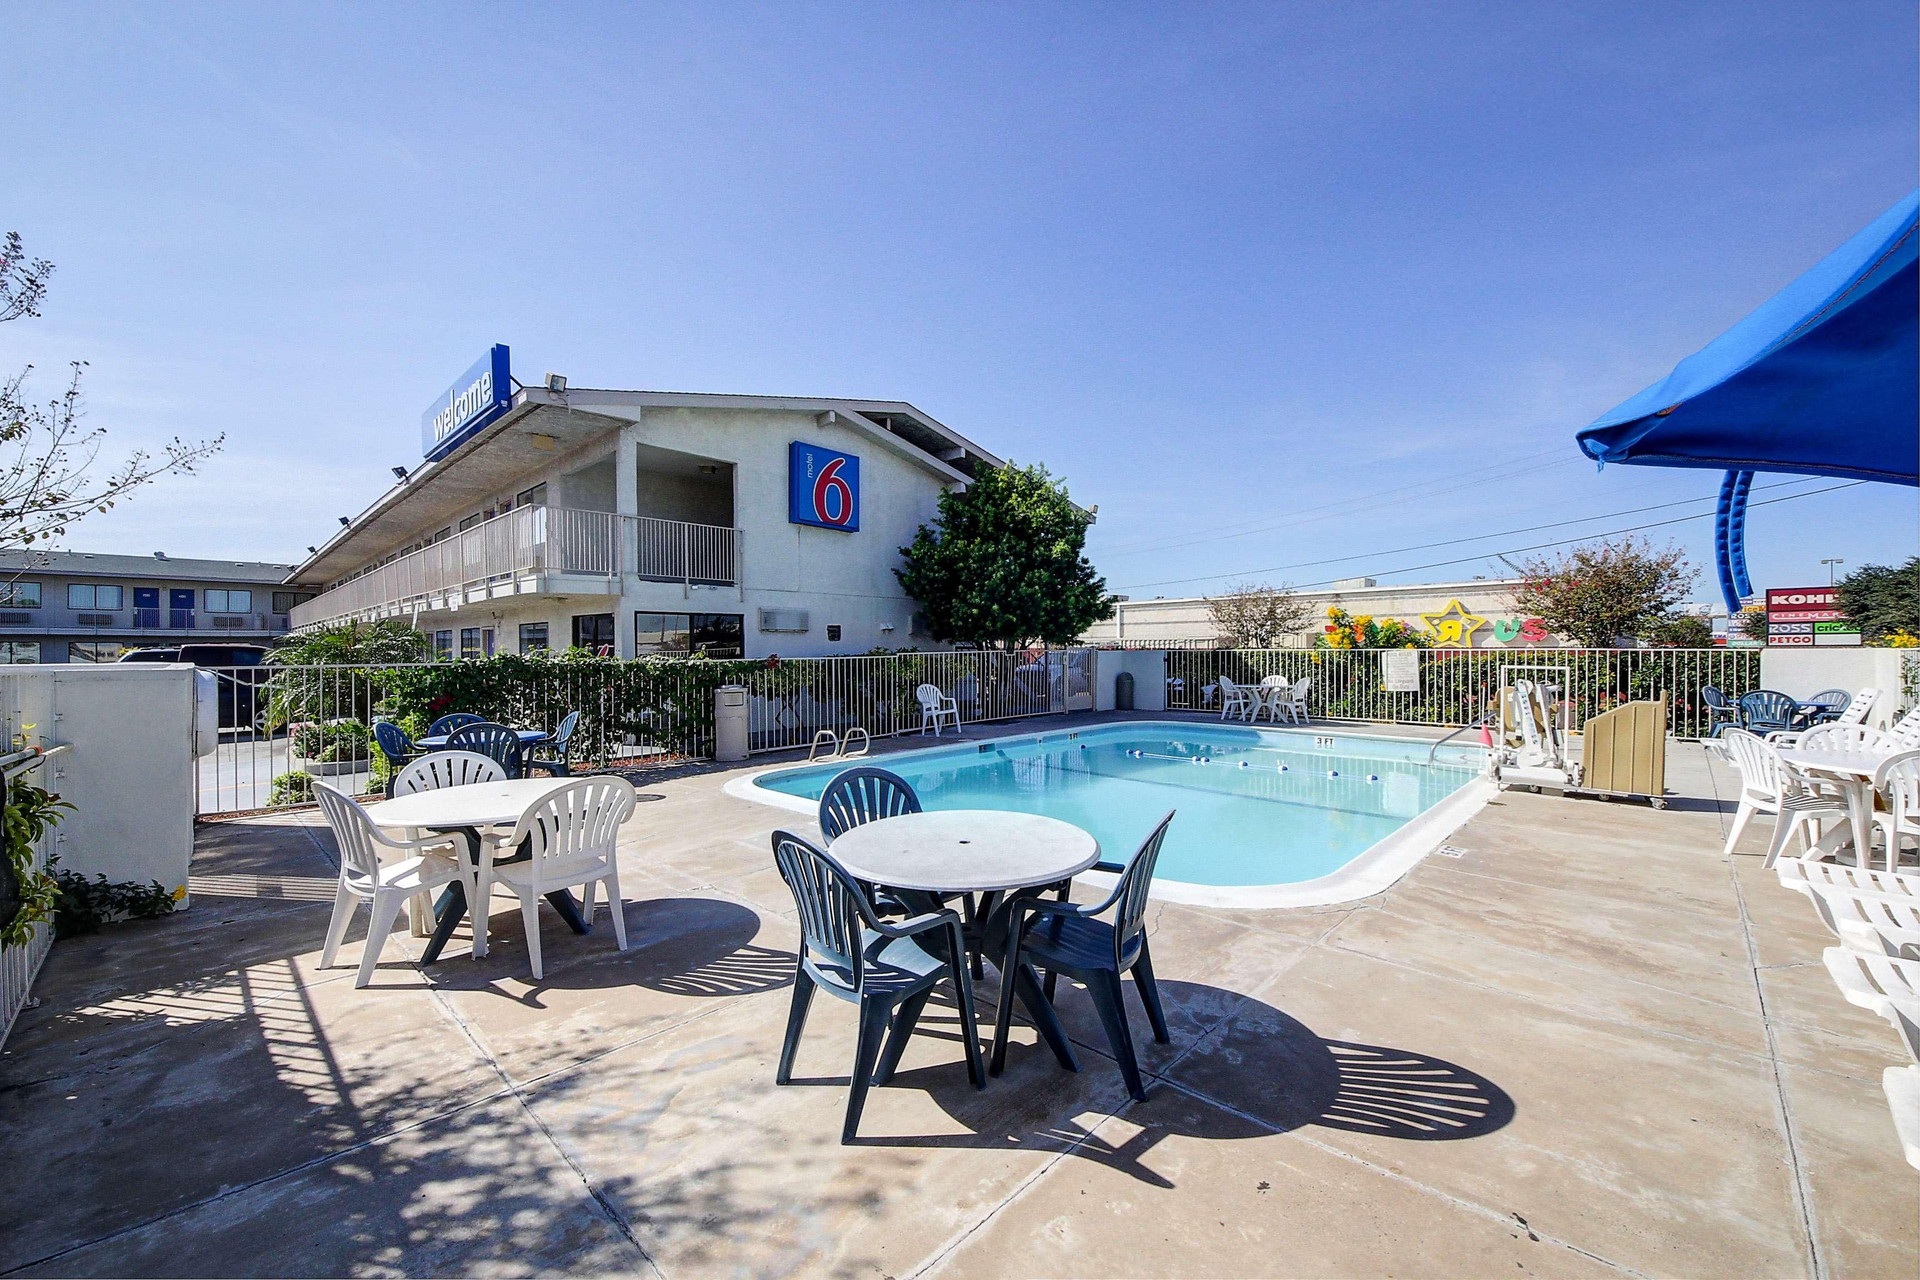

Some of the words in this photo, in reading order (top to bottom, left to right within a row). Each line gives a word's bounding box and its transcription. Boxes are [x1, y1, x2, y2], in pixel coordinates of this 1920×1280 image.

[433, 371, 492, 442] welcome
[806, 453, 814, 478] motel
[813, 457, 854, 526] 6
[1769, 623, 1811, 633] ROSS
[1772, 611, 1843, 620] CINEMAR
[1494, 617, 1548, 643] US
[1769, 636, 1811, 644] PETCO
